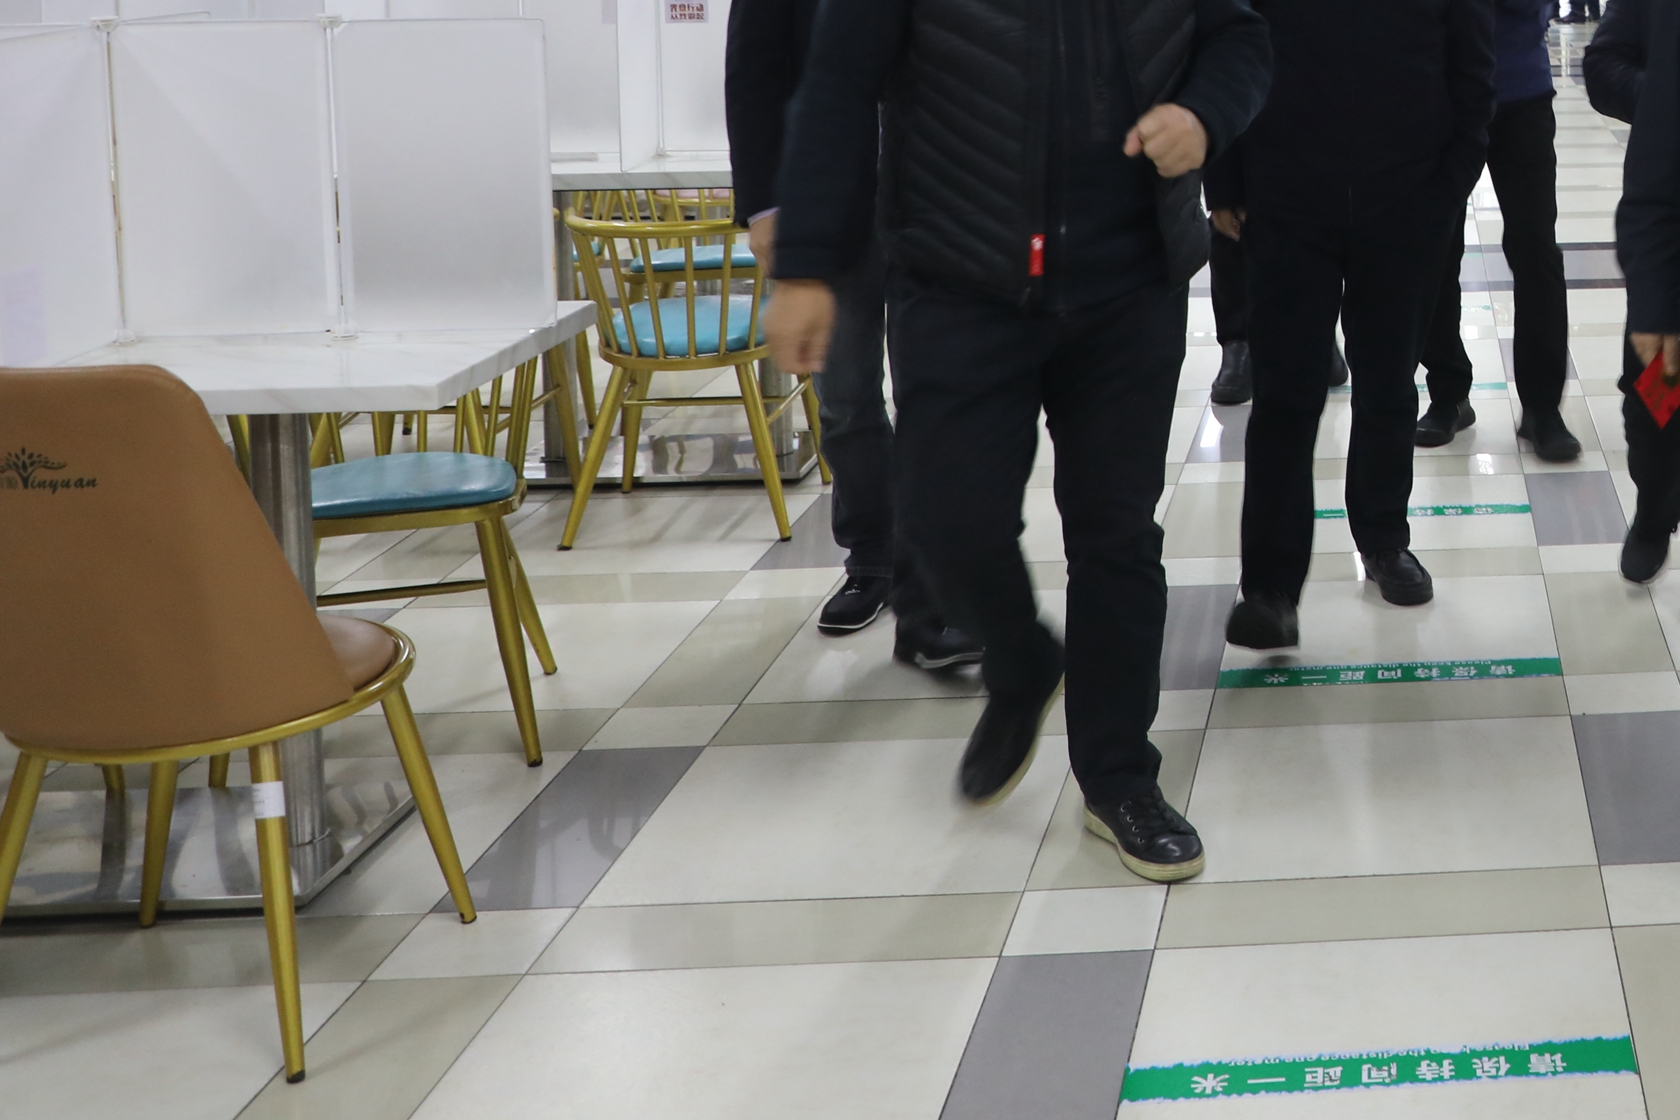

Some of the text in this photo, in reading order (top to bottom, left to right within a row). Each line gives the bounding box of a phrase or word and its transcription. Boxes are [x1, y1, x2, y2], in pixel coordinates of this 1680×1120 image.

[1191, 1053, 1567, 1094] 请保持间距一米
